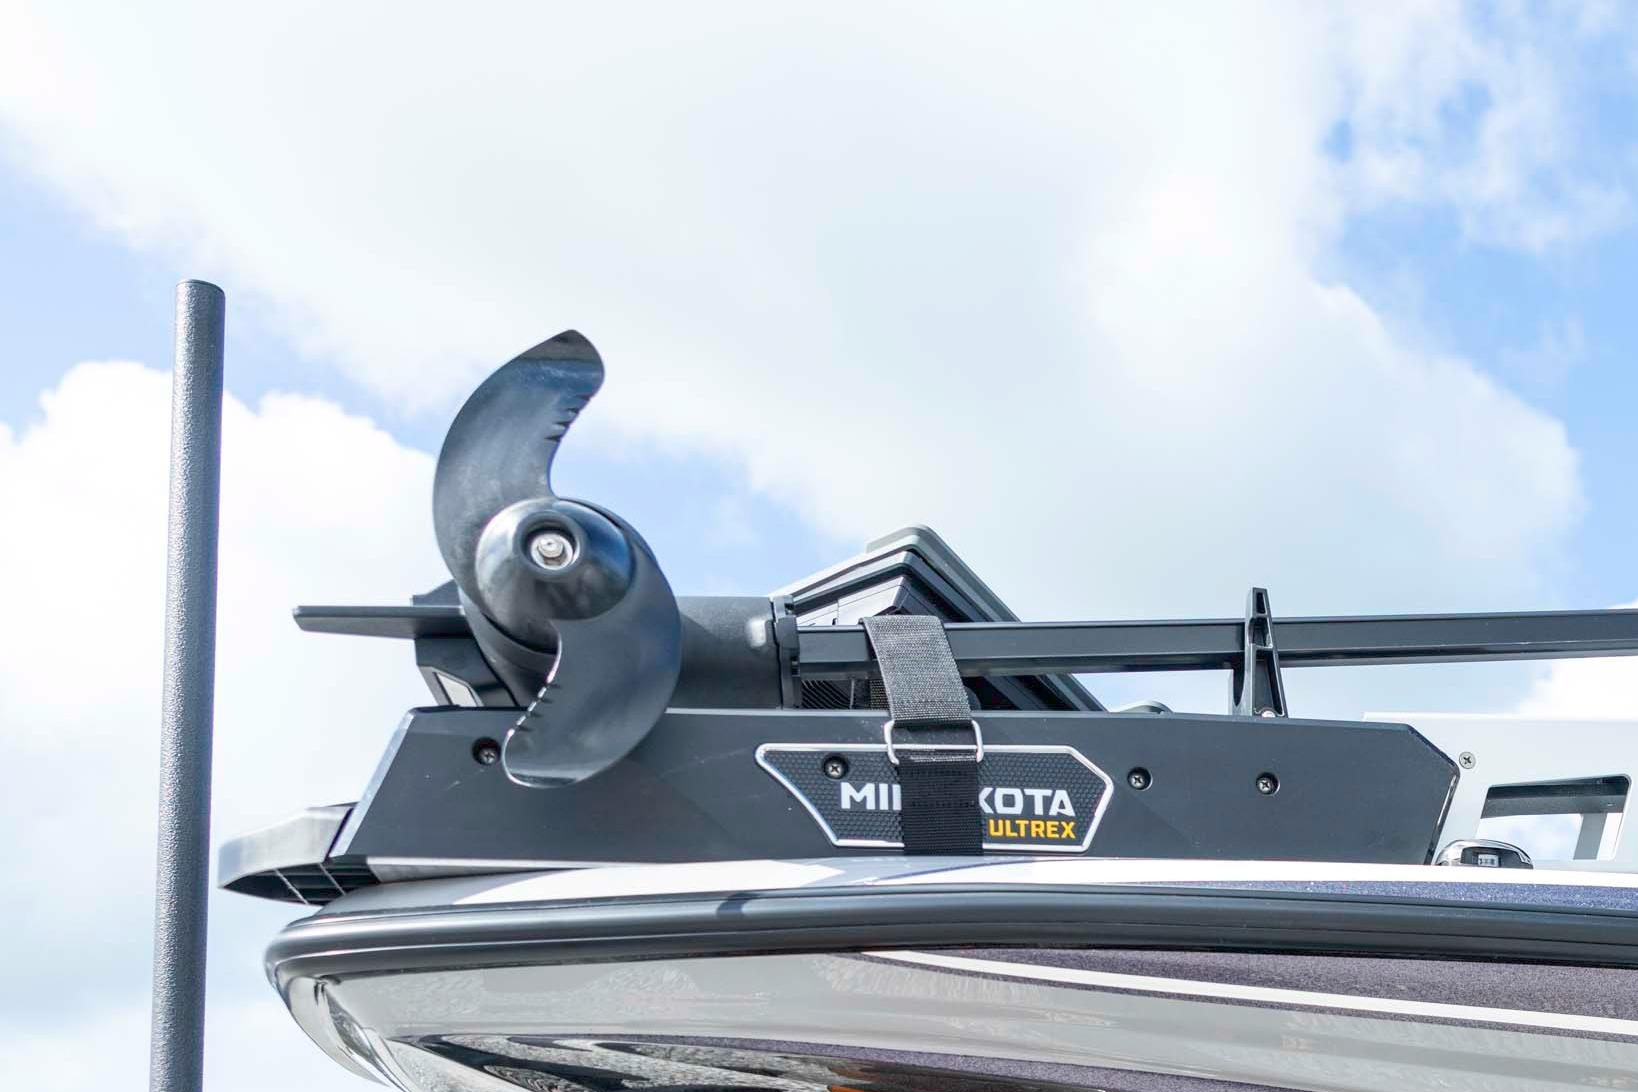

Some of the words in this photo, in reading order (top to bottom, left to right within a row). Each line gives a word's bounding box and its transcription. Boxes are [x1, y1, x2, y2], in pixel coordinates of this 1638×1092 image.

[840, 781, 903, 812] MI
[977, 786, 1077, 817] KOTA
[987, 818, 1077, 840] ULTREX
